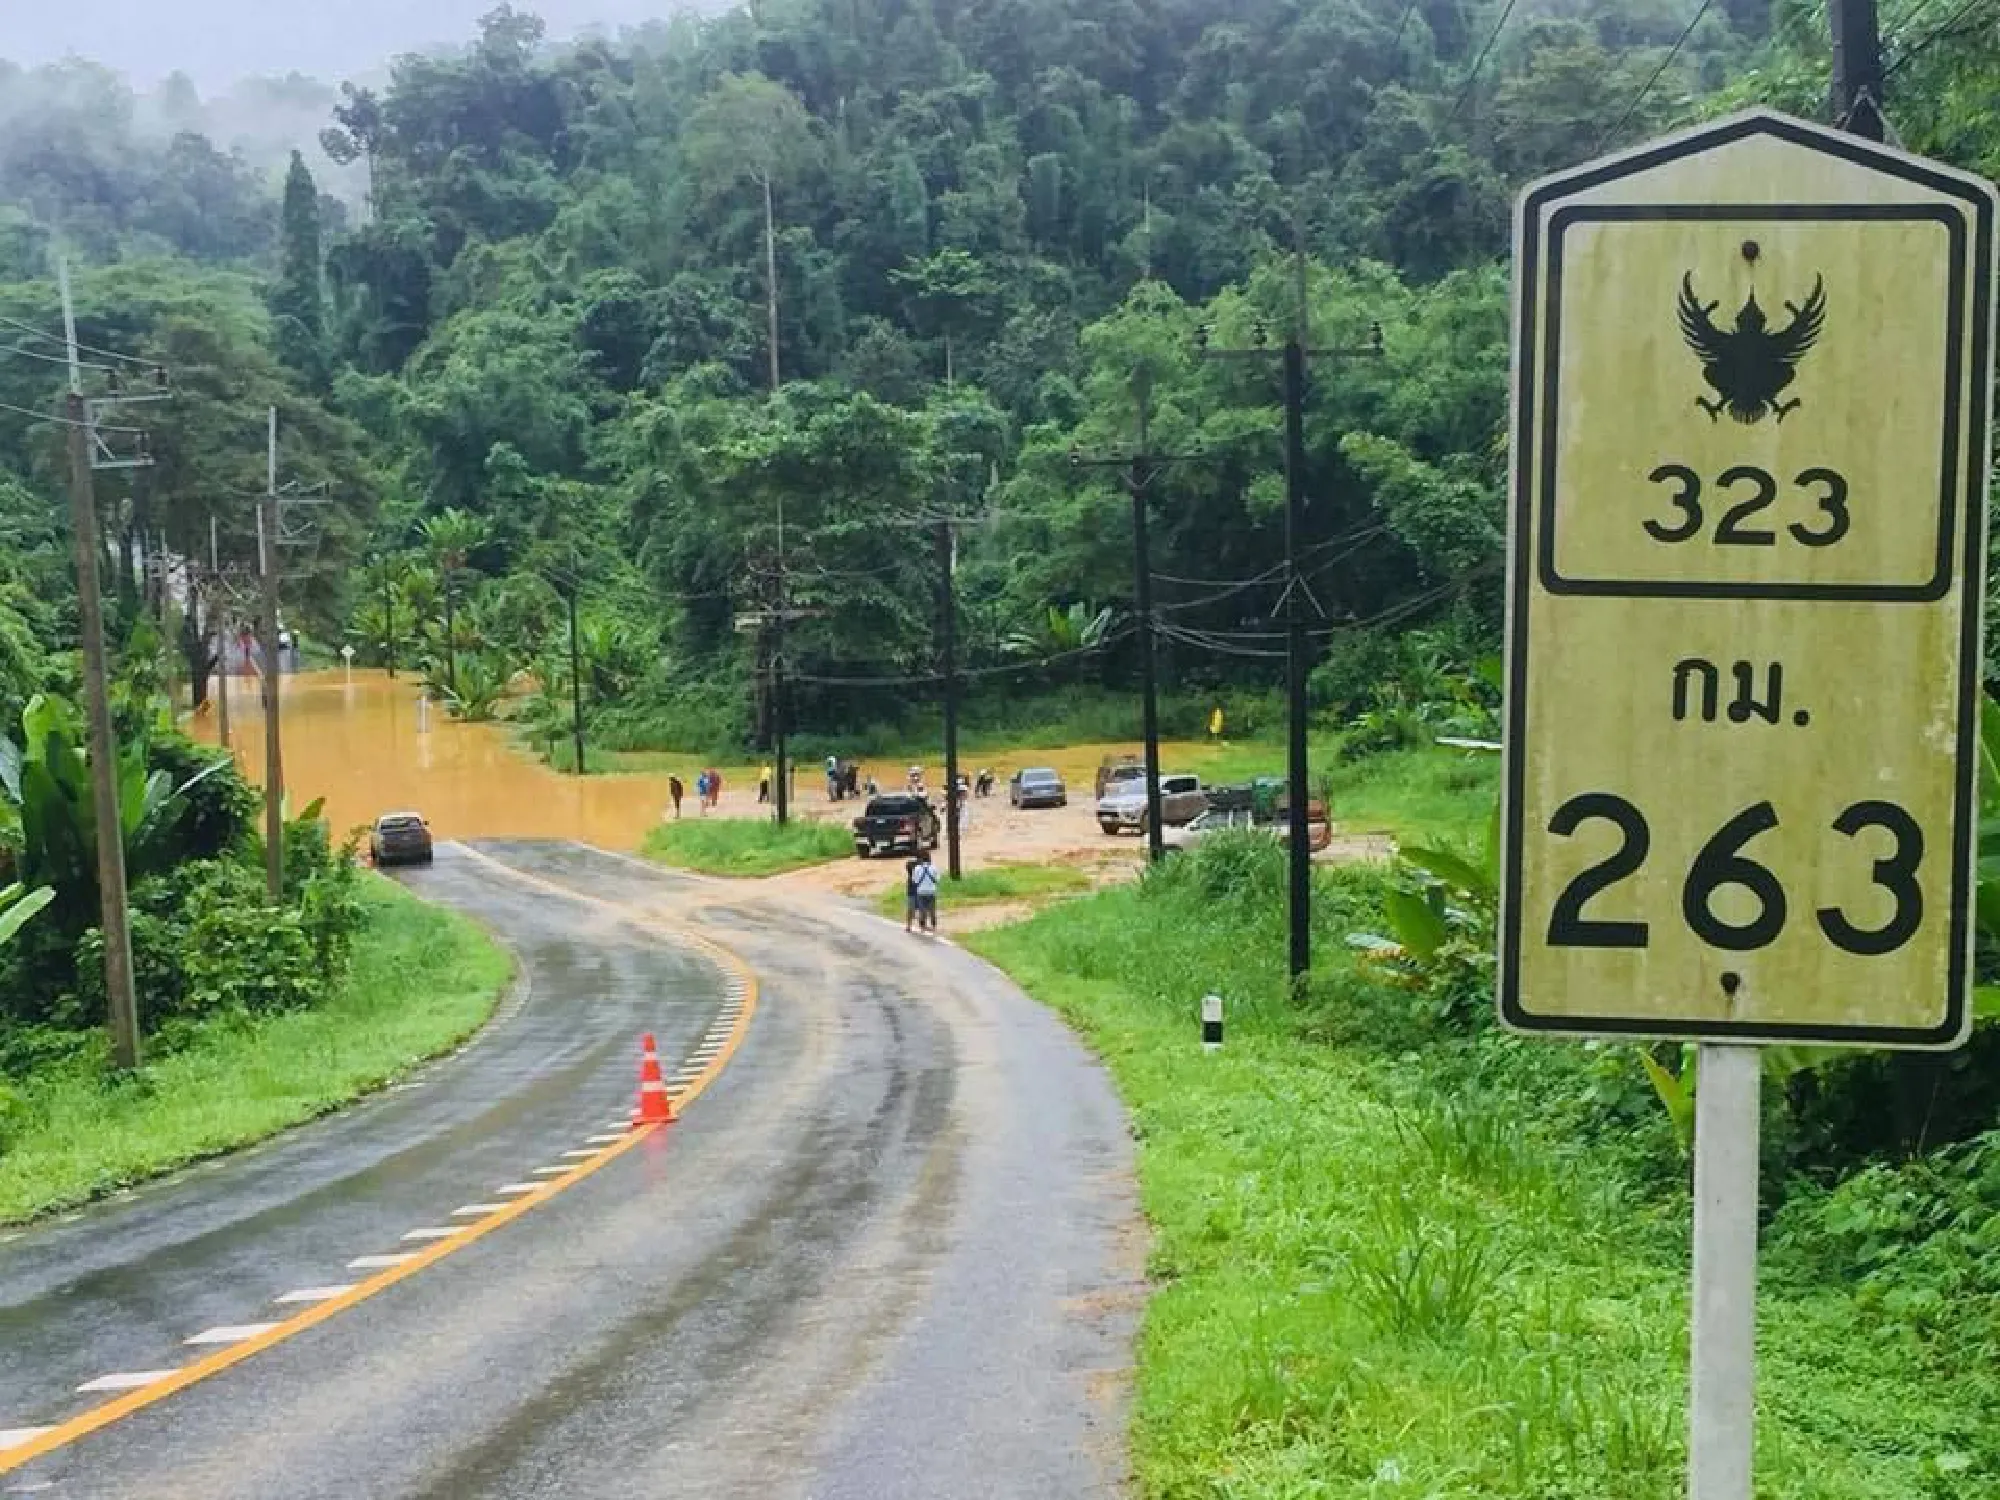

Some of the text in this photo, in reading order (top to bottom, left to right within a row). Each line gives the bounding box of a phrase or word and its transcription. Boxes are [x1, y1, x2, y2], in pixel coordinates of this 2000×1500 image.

[1642, 464, 1851, 547] 323
[1672, 657, 1811, 728] กม.
[1546, 793, 1924, 957] 263
